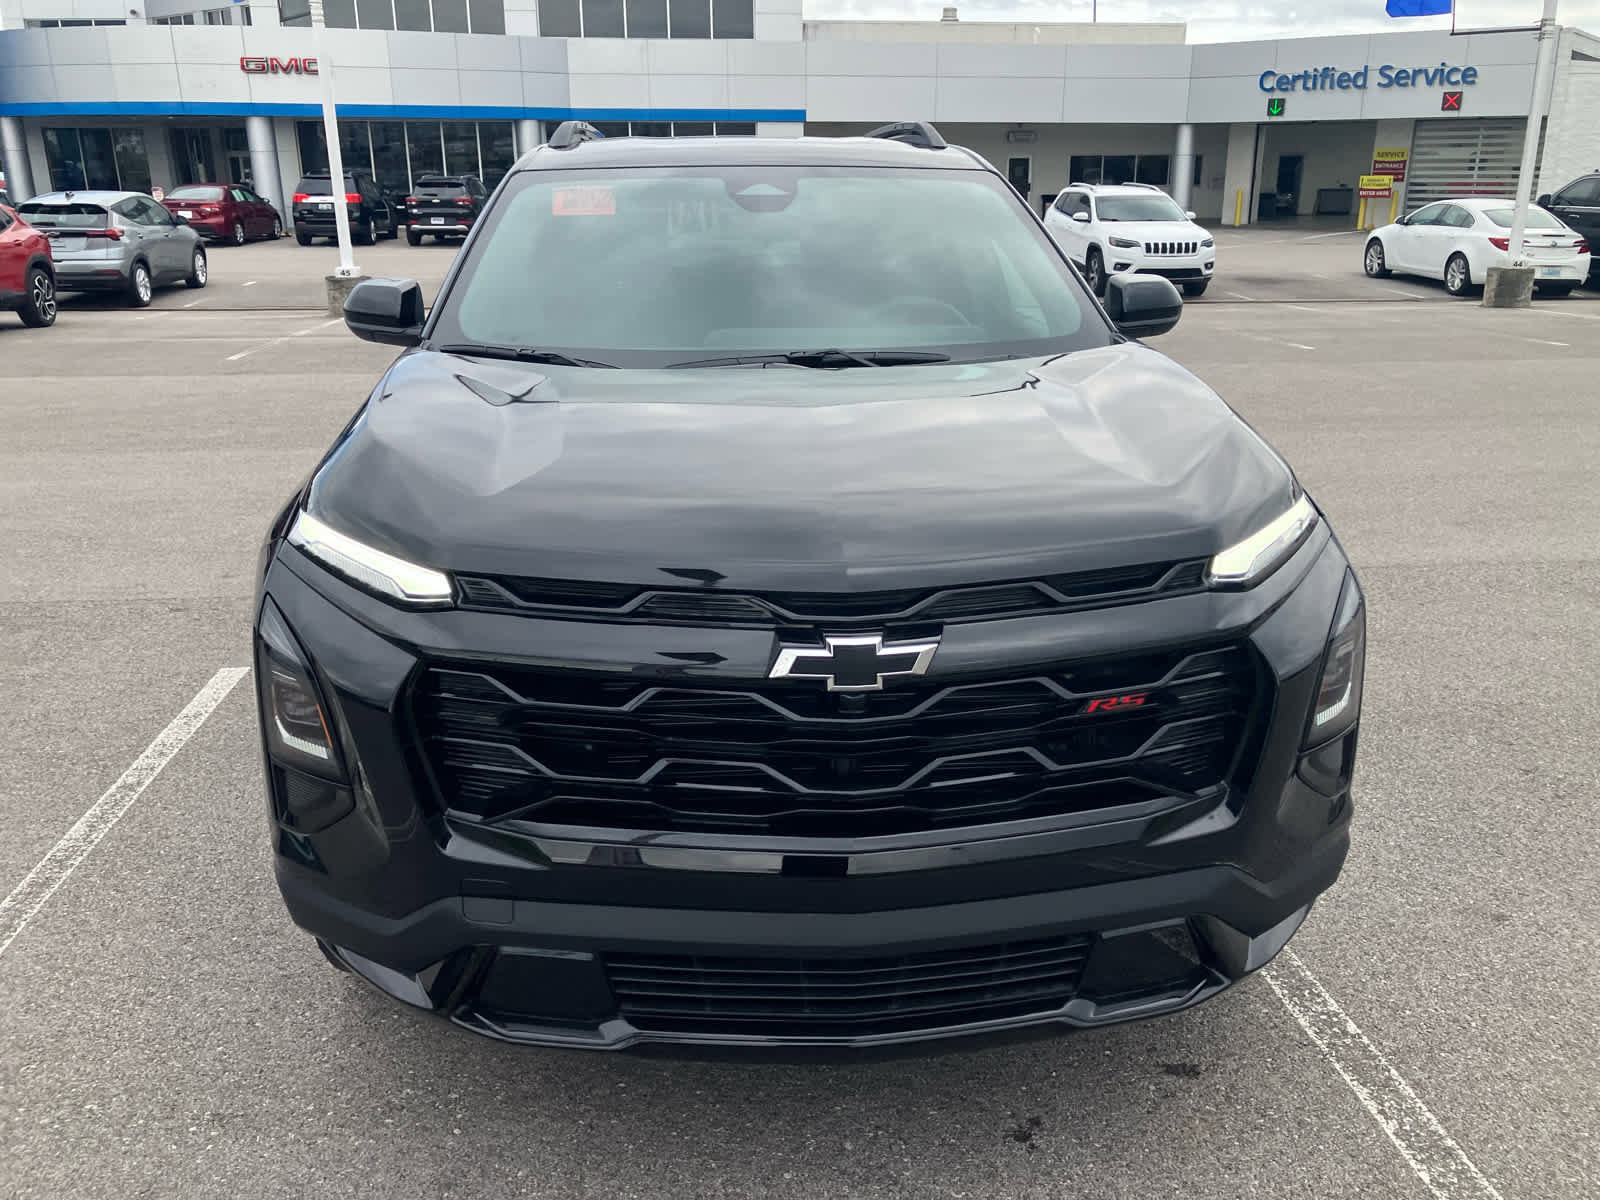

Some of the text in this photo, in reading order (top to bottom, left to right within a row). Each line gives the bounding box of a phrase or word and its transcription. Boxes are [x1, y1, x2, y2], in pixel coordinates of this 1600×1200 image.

[240, 57, 319, 74] GMC
[1259, 62, 1478, 92] Certified Service
[1085, 692, 1149, 712] RS
